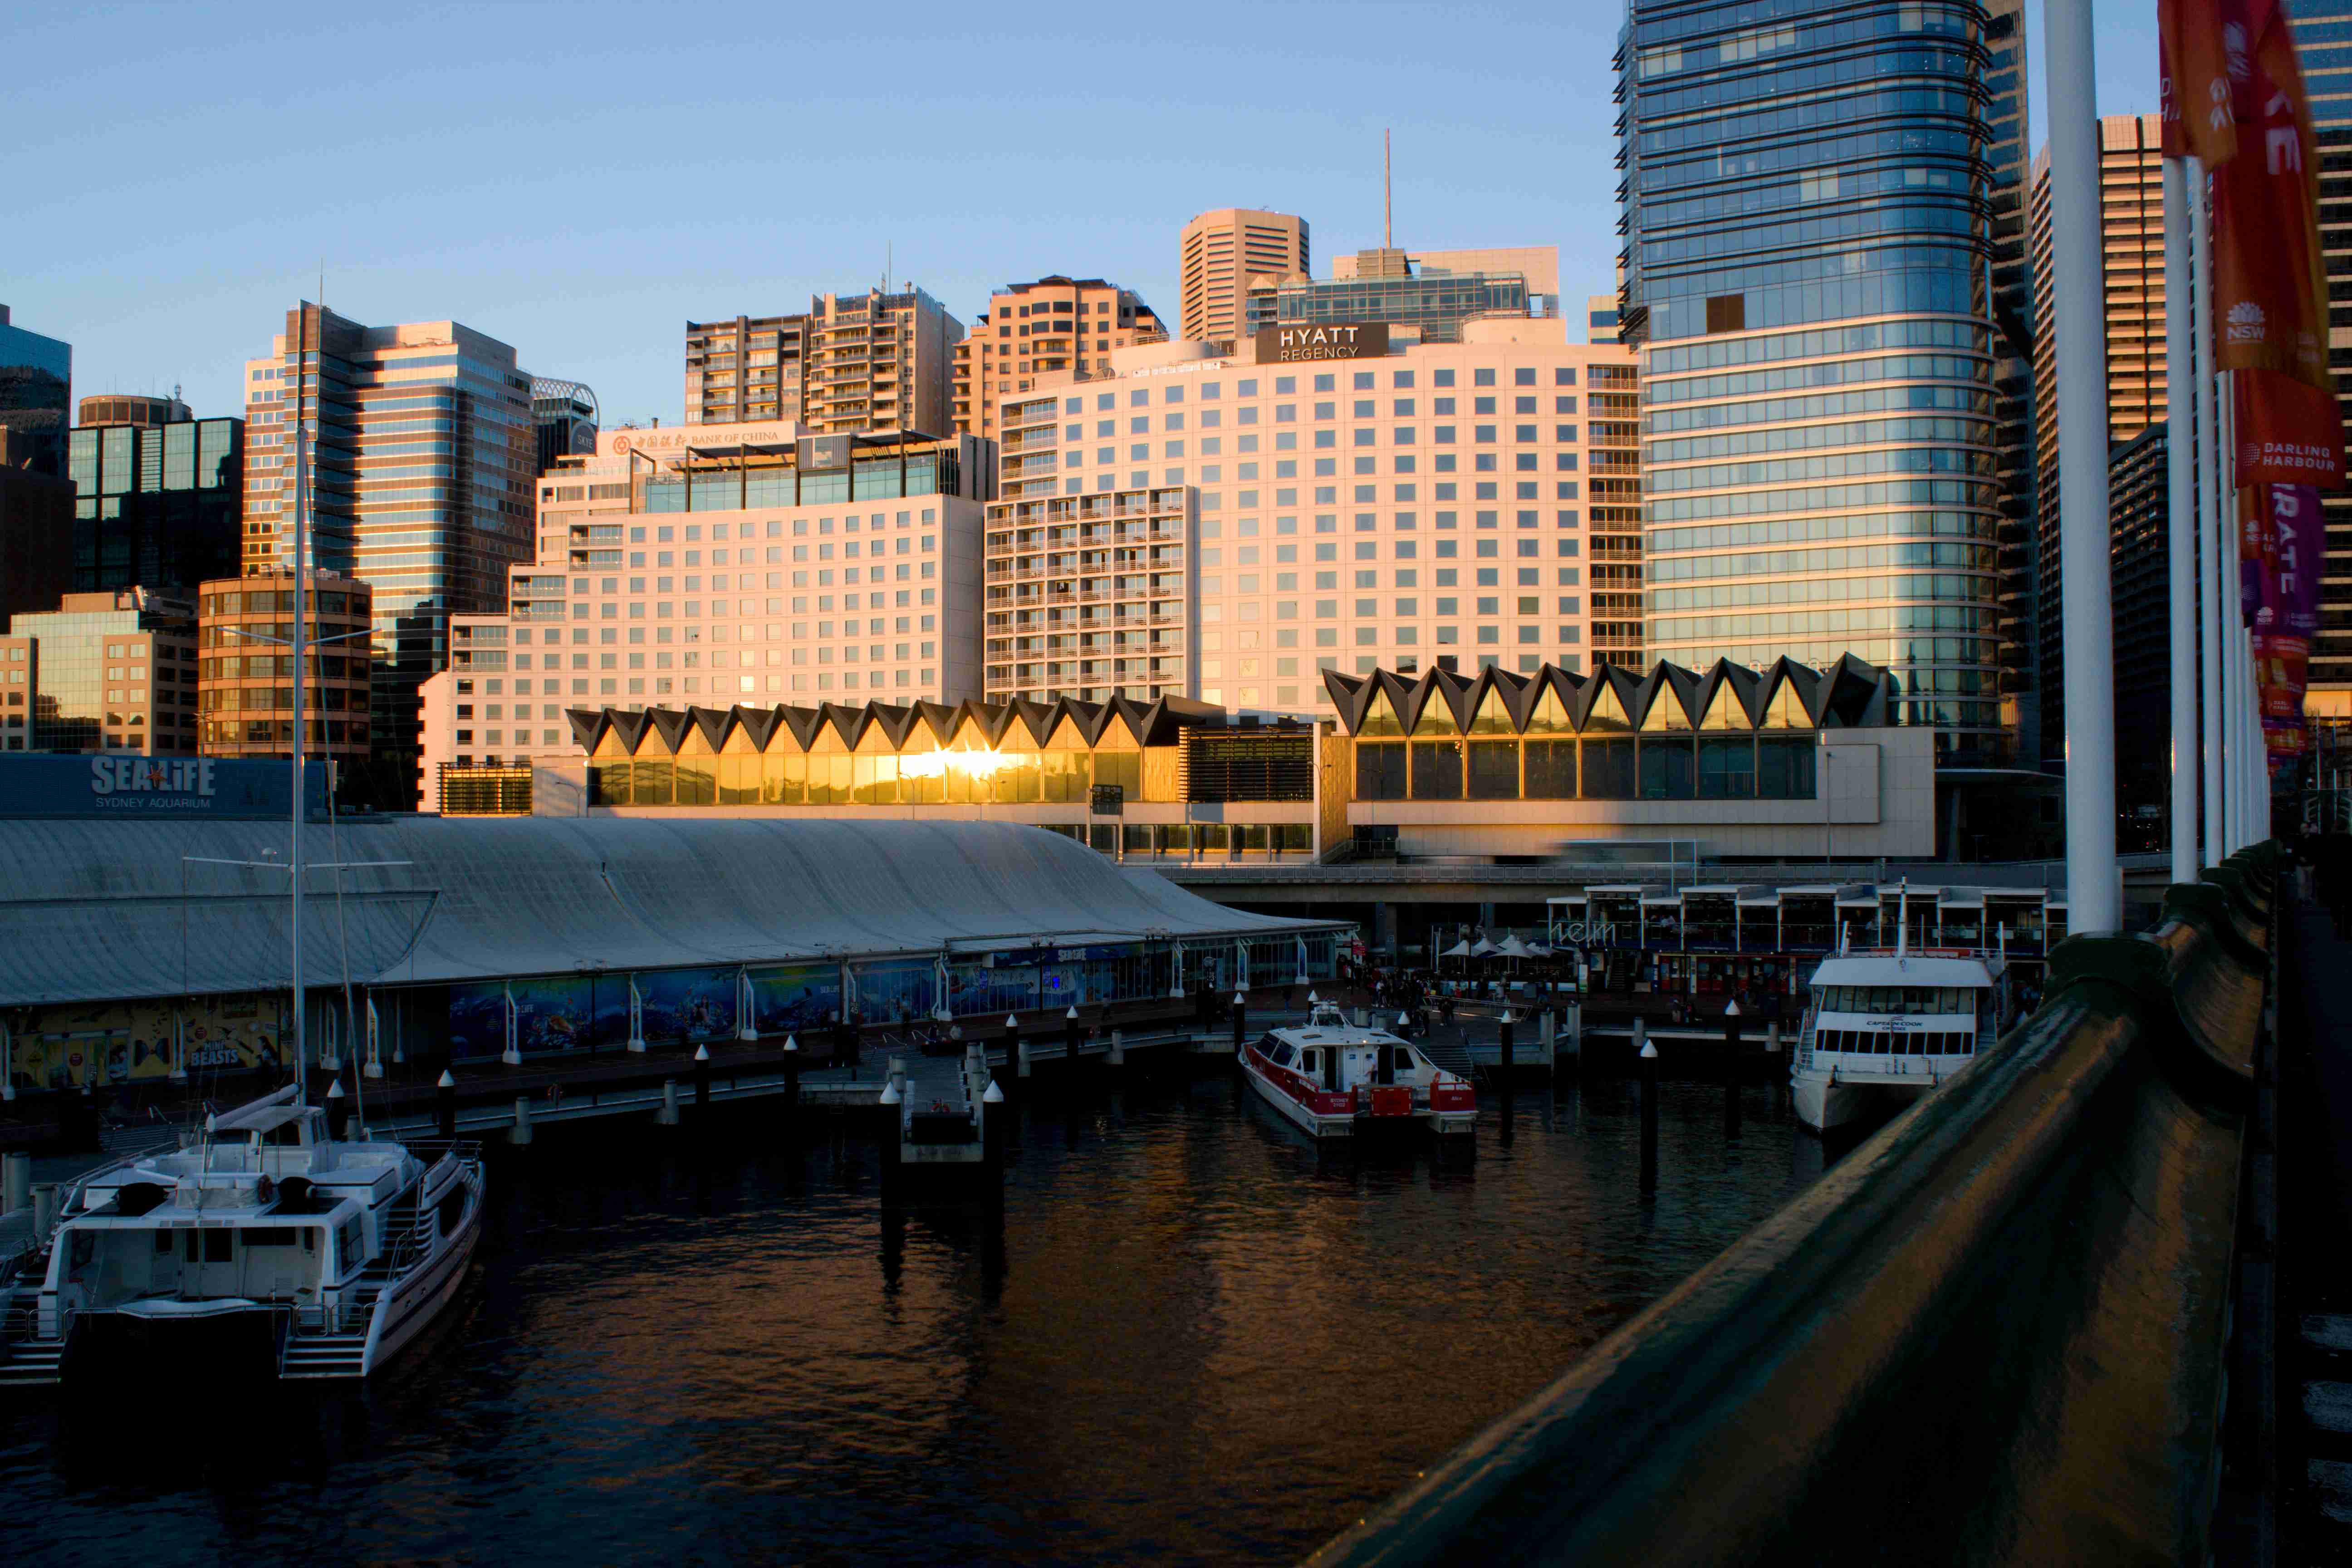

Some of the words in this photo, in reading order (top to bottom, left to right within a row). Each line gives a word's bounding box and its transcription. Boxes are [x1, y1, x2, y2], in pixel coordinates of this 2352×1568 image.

[1281, 327, 1358, 347] HYATT
[2226, 325, 2265, 341] NSW
[1281, 347, 1359, 362] REGENCY
[691, 434, 722, 445] BANK
[725, 433, 739, 443] OF
[742, 431, 779, 442] CHINA
[2264, 441, 2331, 458] DARLING
[2262, 456, 2336, 472] HARBOUR
[91, 755, 153, 794] SEA
[96, 798, 144, 808] SYDNEY
[148, 798, 211, 808] AQUARIUM
[190, 1049, 240, 1067] BEASTS
